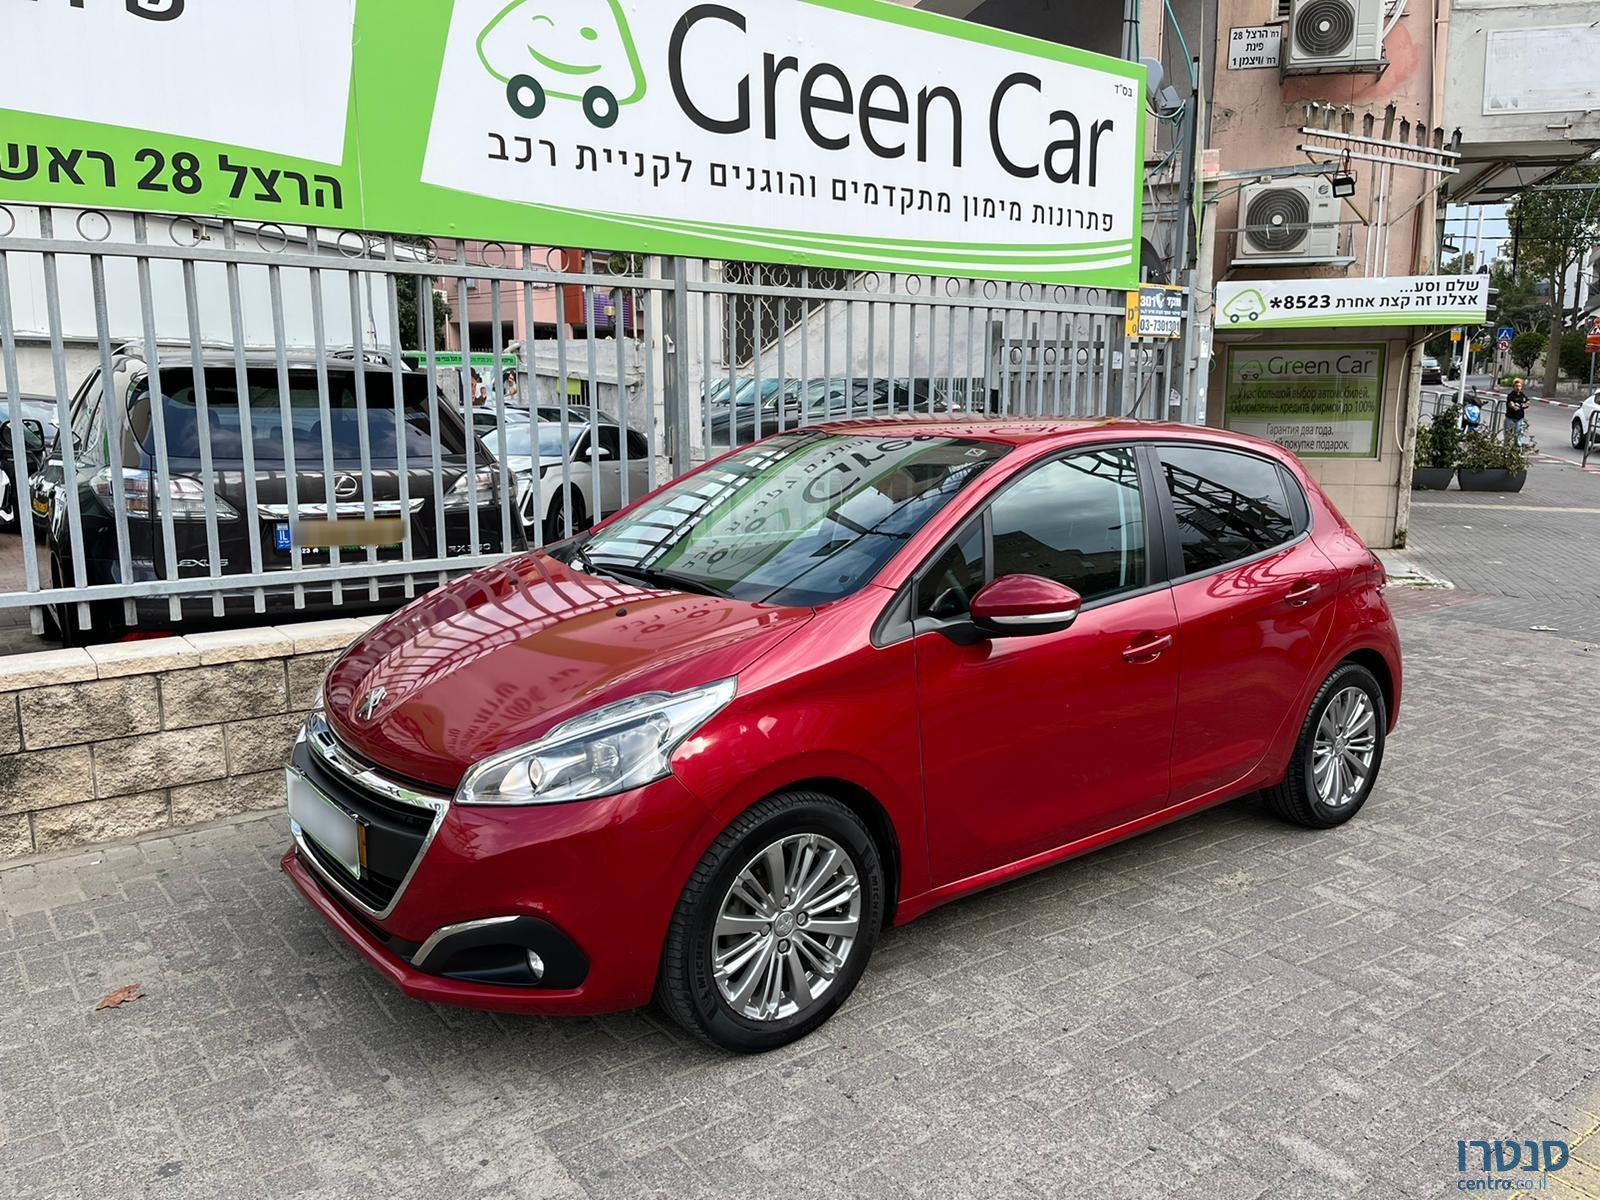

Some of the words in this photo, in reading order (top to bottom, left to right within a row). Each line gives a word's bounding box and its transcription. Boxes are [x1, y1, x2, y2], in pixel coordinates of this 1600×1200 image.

[1233, 31, 1243, 41] 28
[1246, 29, 1269, 39] הרצל
[1246, 42, 1264, 52] פינת
[1232, 57, 1237, 66] 1
[668, 3, 962, 168] Green
[989, 72, 1114, 188] Car
[488, 132, 556, 167] רכב
[134, 148, 203, 195] 28
[575, 144, 693, 187] לקניית
[218, 154, 343, 210] הרצל
[711, 162, 816, 199] והוגנים
[832, 177, 951, 215] מתקדמים
[963, 194, 1022, 223] מימון
[1032, 204, 1113, 232] פתרונות
[1400, 281, 1440, 293] וסע...
[1446, 279, 1480, 292] שלם
[1336, 298, 1374, 309] אחרת
[1379, 297, 1411, 310] קצת
[1415, 295, 1431, 306] זה
[1436, 293, 1478, 306] אצלנו
[1268, 356, 1329, 375] Green
[1336, 355, 1372, 374] Car
[1257, 386, 1291, 400] большой
[1292, 386, 1317, 402] выбор
[1280, 403, 1310, 414] кредита
[1342, 403, 1353, 414] до
[1355, 400, 1375, 413] 100%
[1266, 422, 1300, 437] Гарантия
[1300, 425, 1314, 437] два
[1285, 439, 1314, 451] покупке
